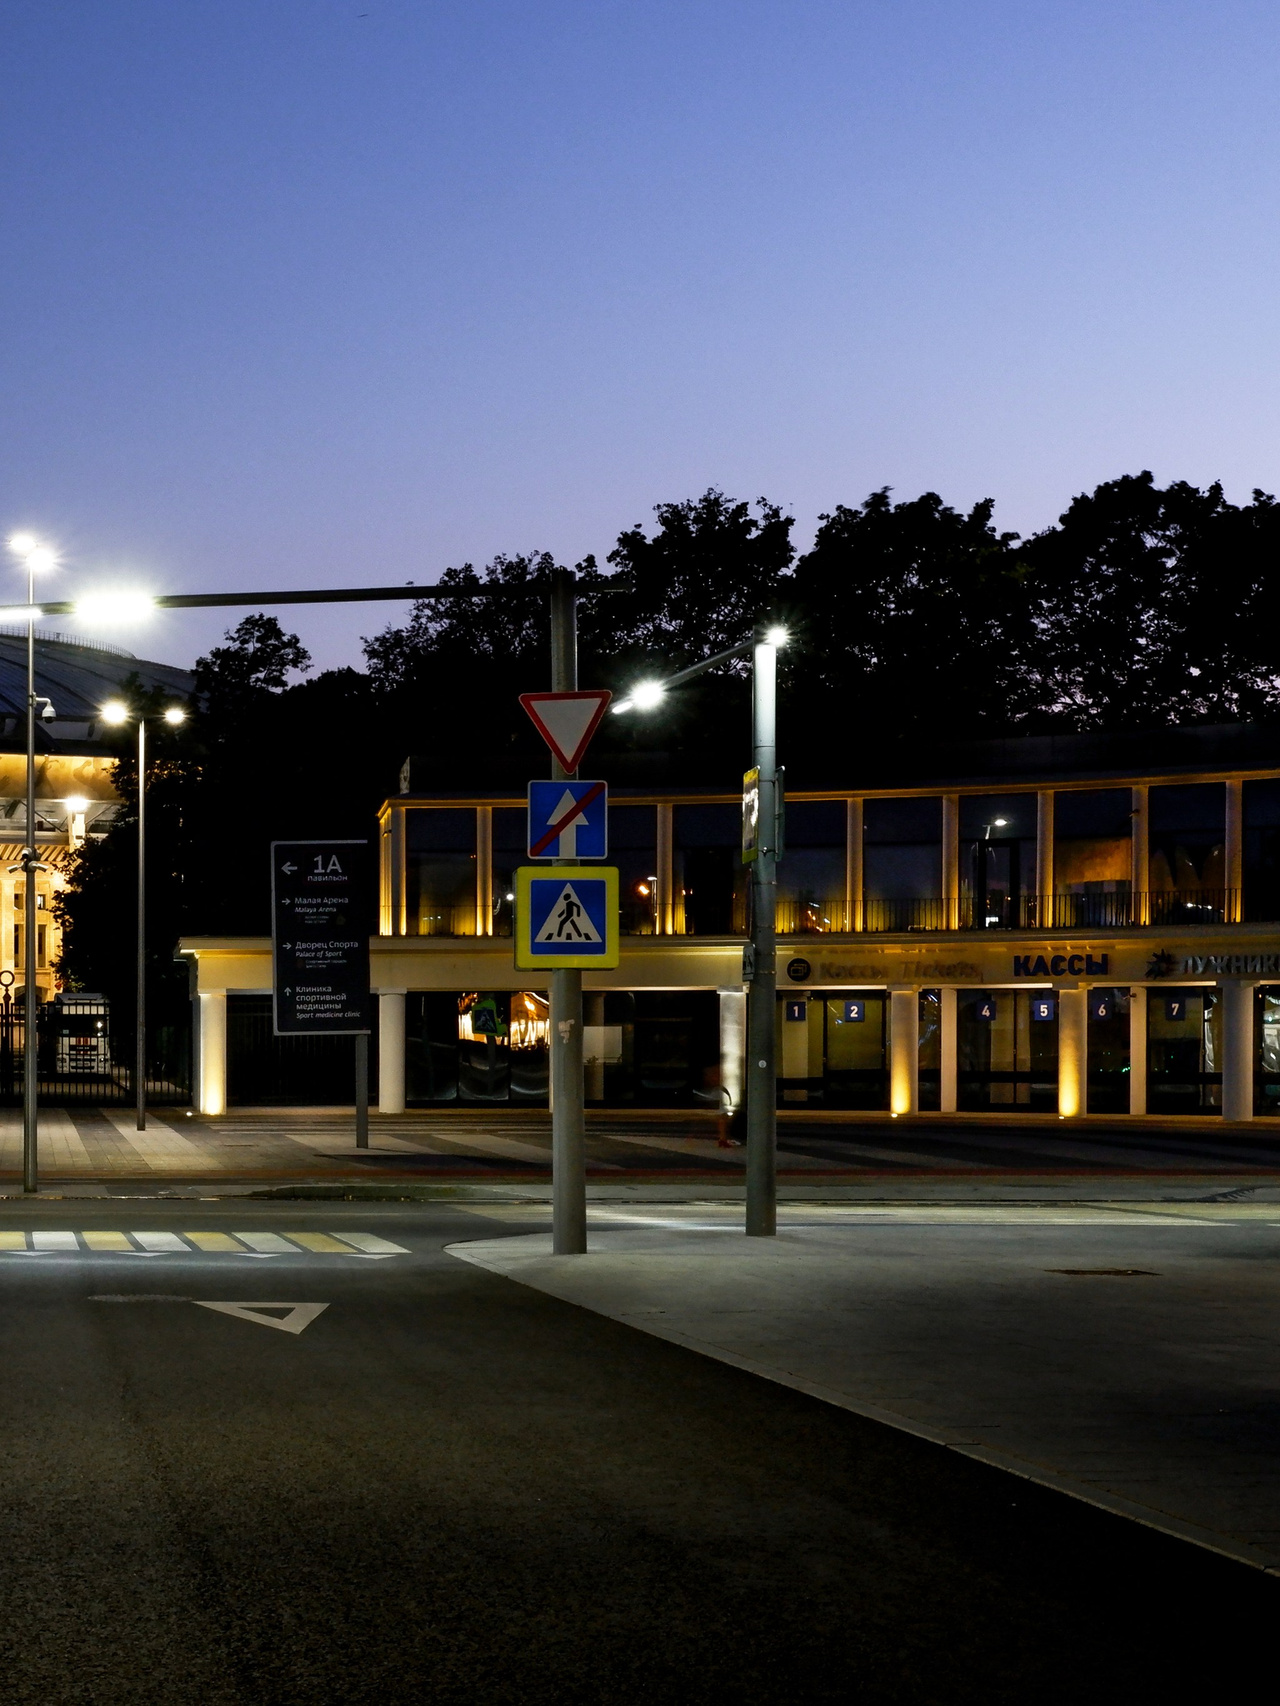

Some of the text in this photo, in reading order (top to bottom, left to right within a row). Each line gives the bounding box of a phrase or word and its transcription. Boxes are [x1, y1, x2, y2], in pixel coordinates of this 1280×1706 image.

[307, 874, 348, 882] павильон
[323, 897, 349, 905] Арена
[295, 941, 359, 950] Дворец Спорта
[325, 950, 342, 958] Sport
[1013, 953, 1109, 976] КАССЫ
[1179, 954, 1280, 974] ЛУЖНИК
[819, 962, 890, 979] Кассы
[296, 993, 347, 1003] спортивной
[296, 1003, 342, 1011] медицины
[792, 1005, 800, 1017] 1
[850, 1005, 858, 1017] 2
[981, 1005, 990, 1017] 4
[1040, 1005, 1048, 1017] 5
[1098, 1004, 1106, 1016] 6
[1171, 1003, 1180, 1016] 7
[296, 1012, 314, 1020] Sport
